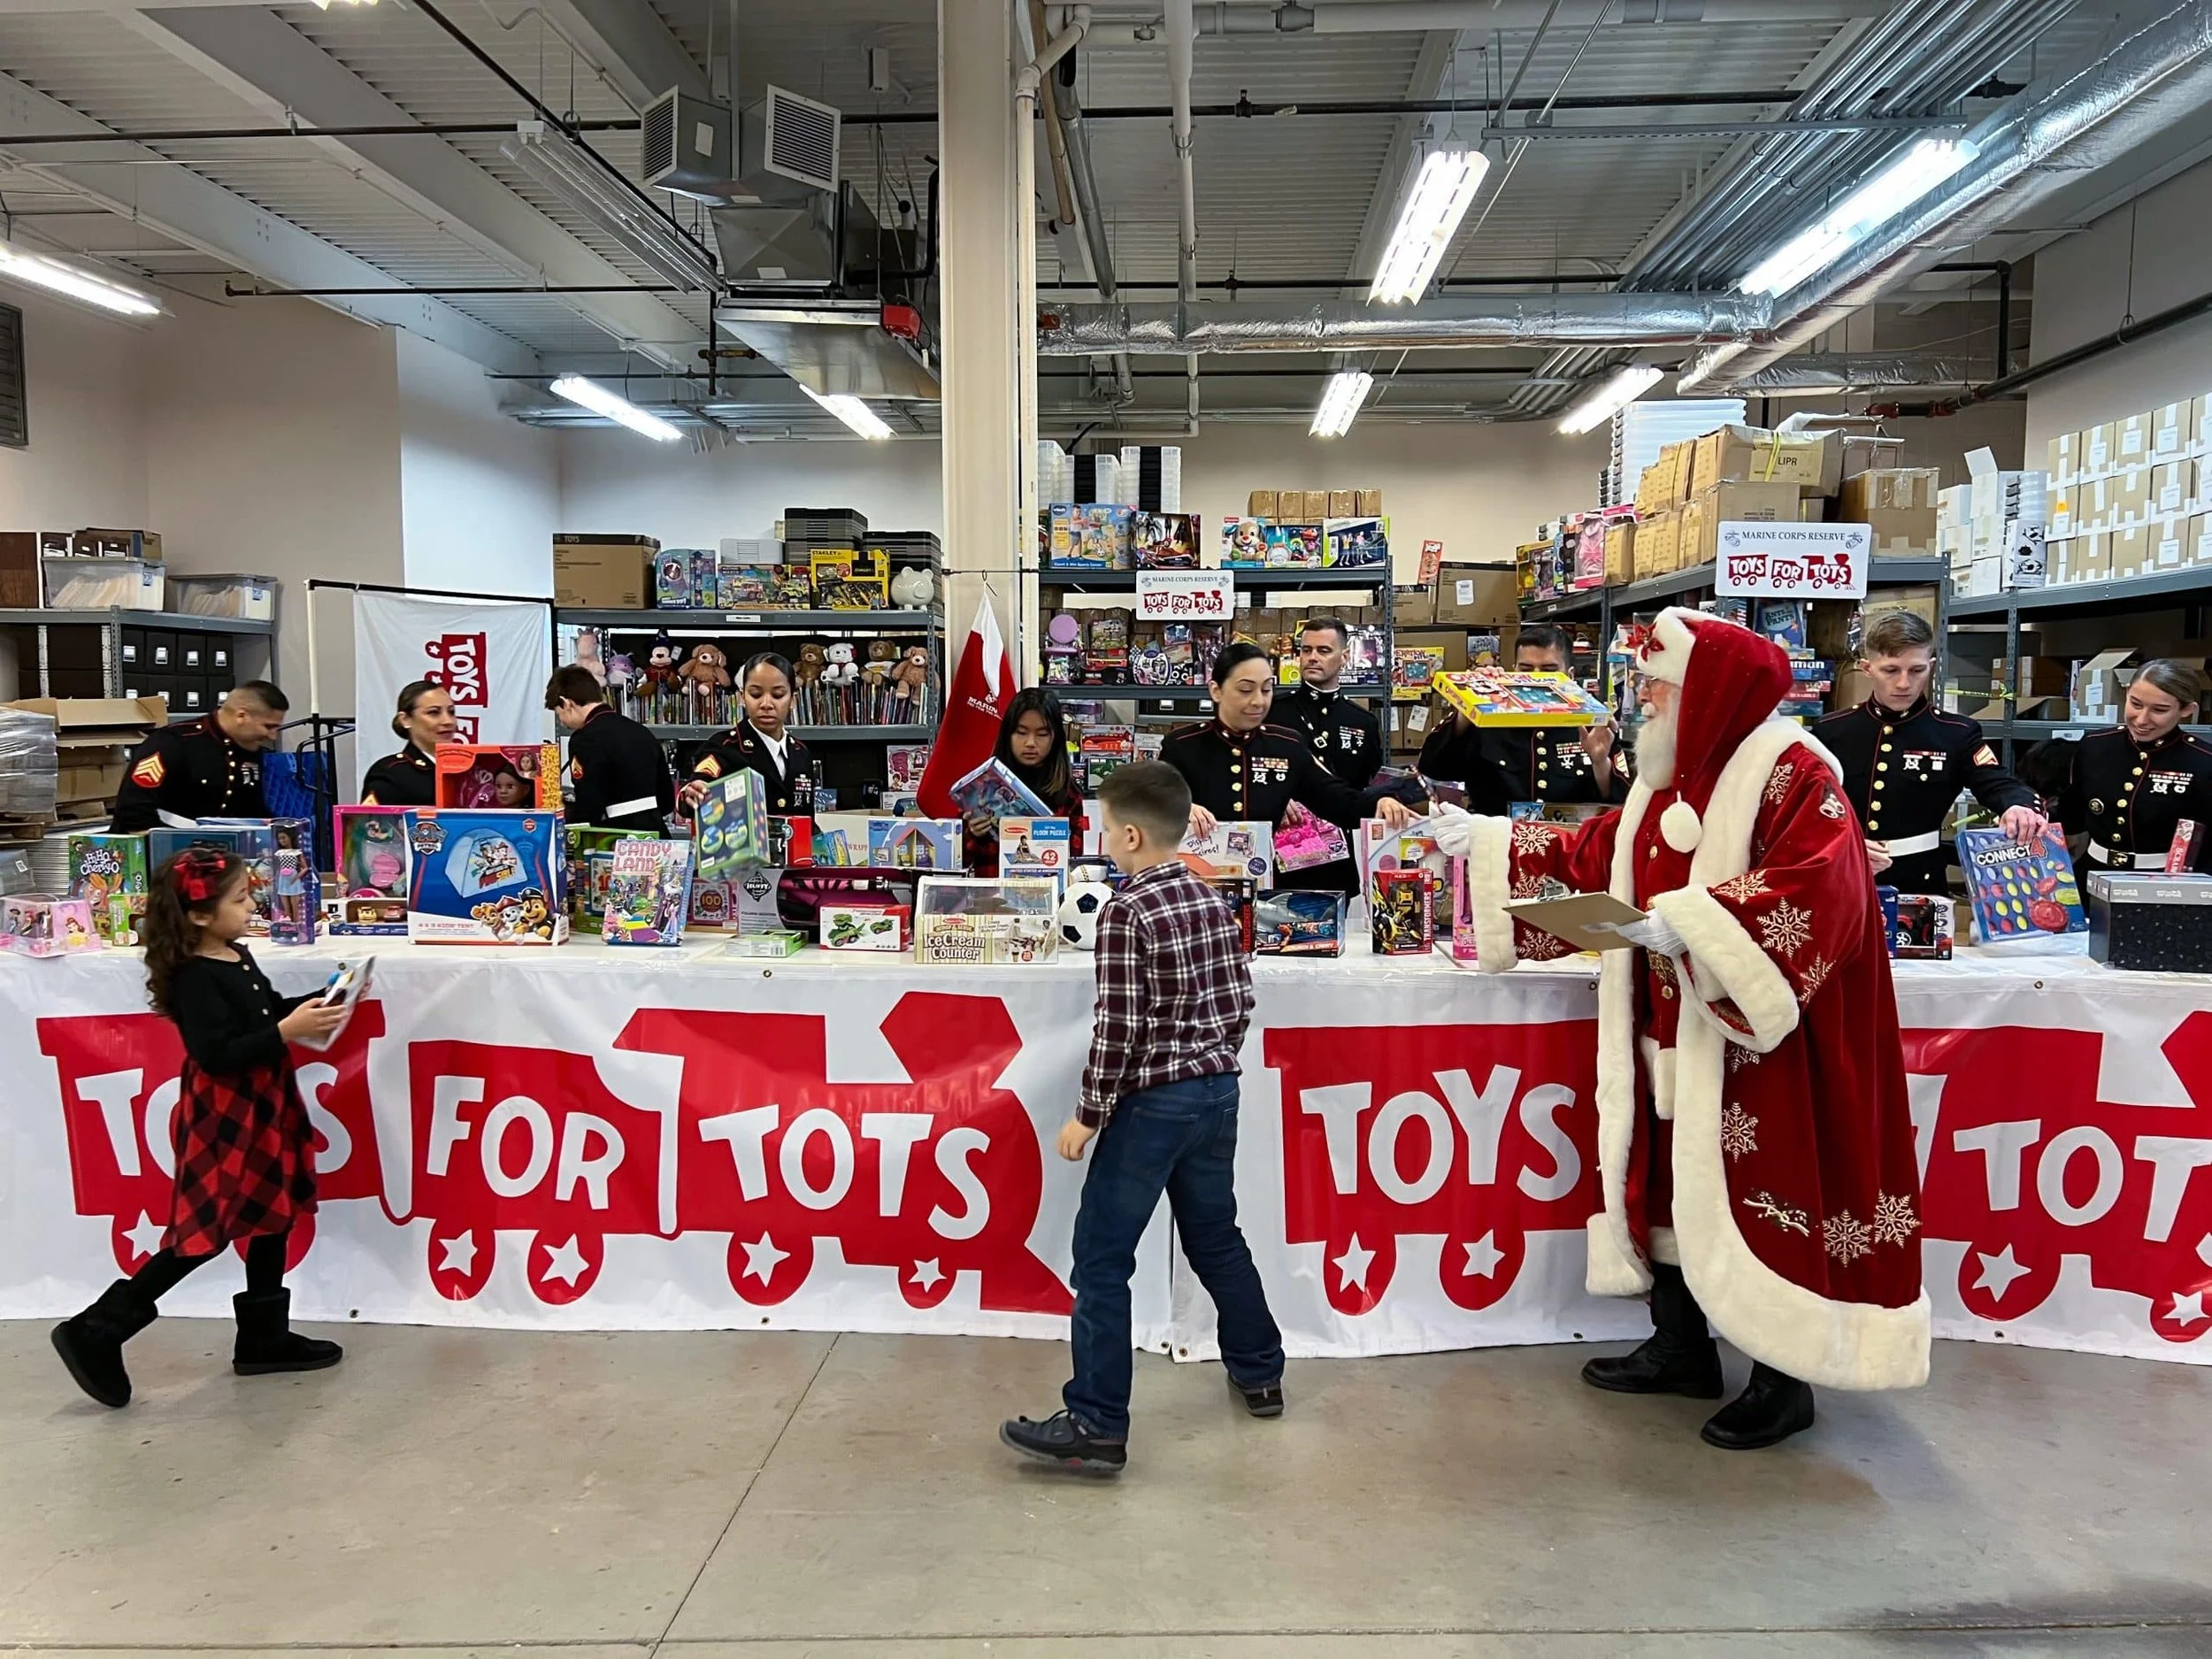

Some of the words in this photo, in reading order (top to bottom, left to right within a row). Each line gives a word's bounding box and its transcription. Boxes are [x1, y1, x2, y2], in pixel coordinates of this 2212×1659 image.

[1742, 531, 1776, 540] MARINE
[1778, 532, 1806, 541] CORPS
[1731, 557, 1765, 575] TOYS
[1773, 563, 1801, 579] FOR
[1810, 565, 1847, 582] TOTS
[1146, 595, 1167, 607] TOYS
[1173, 596, 1190, 607] FOR
[1196, 597, 1220, 610] TOTS
[448, 639, 480, 702] TOYS
[968, 696, 998, 714] MARIN
[618, 841, 672, 857] CANDY
[1043, 852, 1056, 861] 42
[1976, 845, 2032, 865] CONNECT
[2031, 836, 2046, 857] 4
[614, 857, 656, 872] LAND
[702, 896, 722, 906] 100
[932, 948, 979, 960] Counter
[75, 1063, 352, 1176] TS
[426, 1075, 625, 1210] FOR
[698, 1103, 991, 1240] TOTS
[1299, 1064, 1581, 1204] TOYS
[1953, 1118, 2212, 1268] TOT
